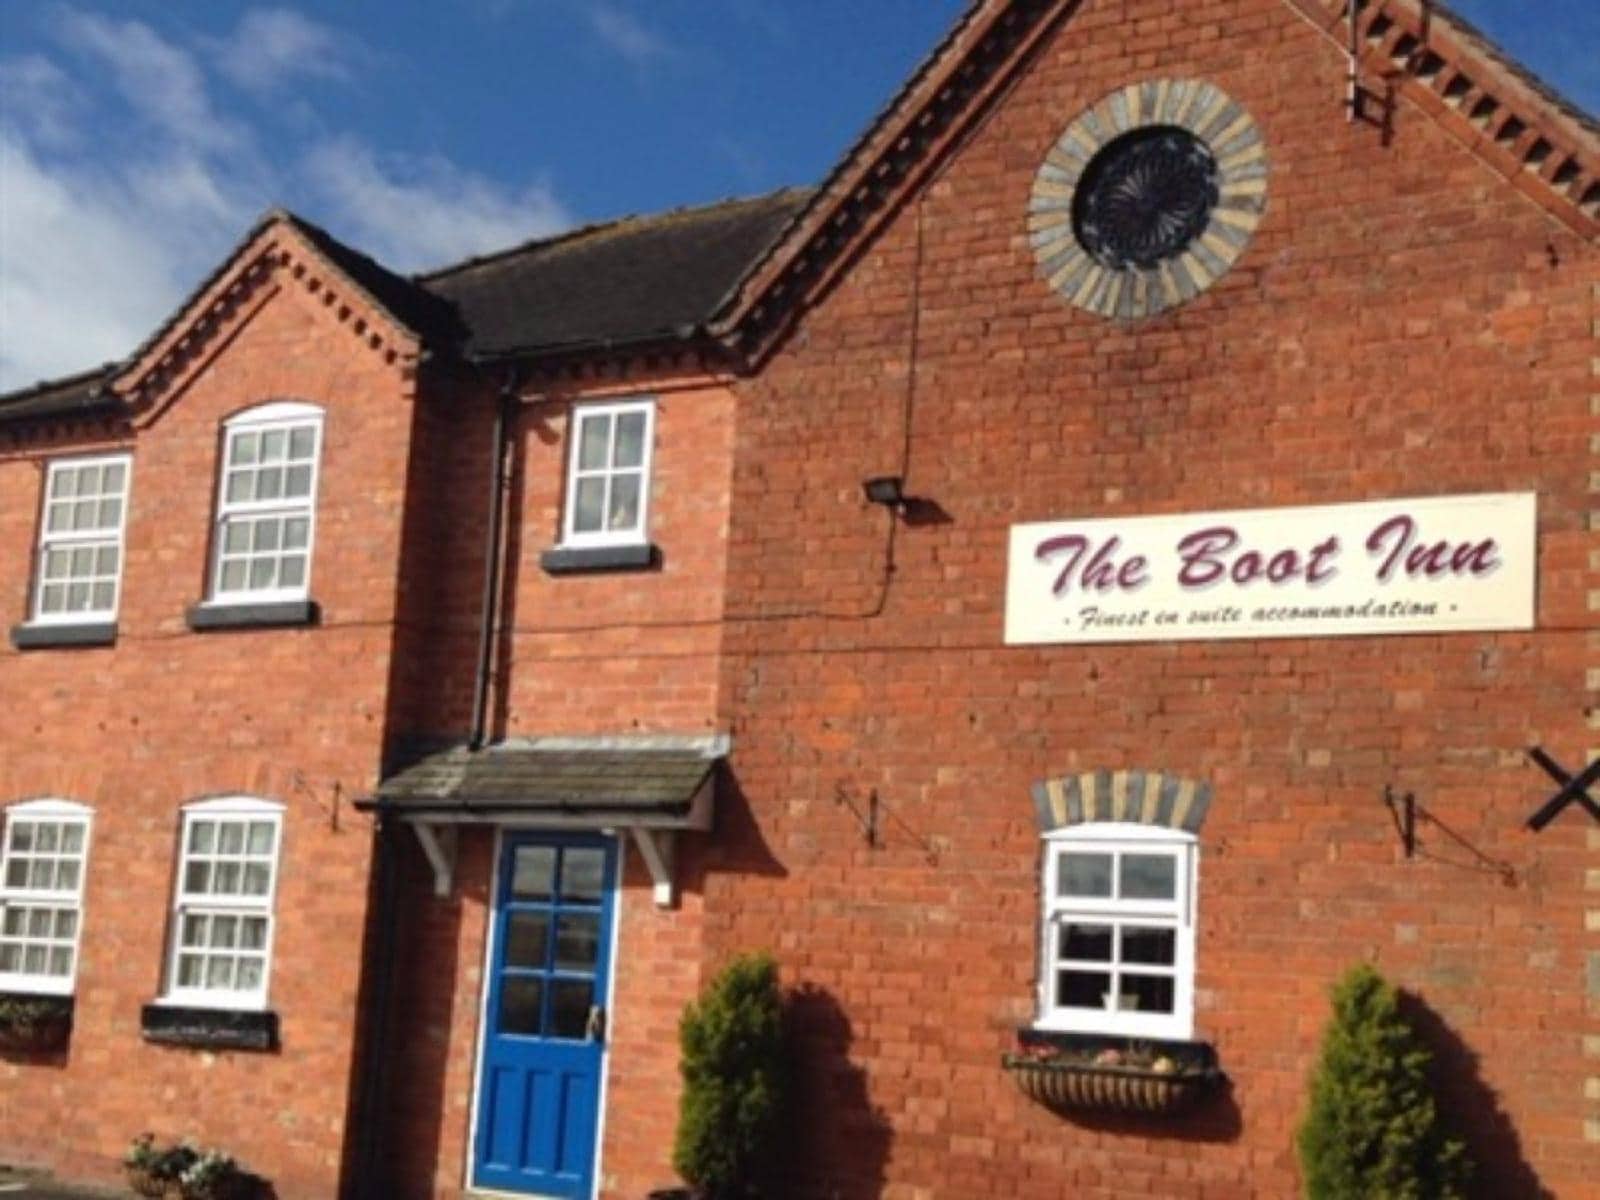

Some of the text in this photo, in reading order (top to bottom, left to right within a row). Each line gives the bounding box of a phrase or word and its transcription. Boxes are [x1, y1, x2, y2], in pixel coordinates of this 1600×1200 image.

[1034, 513, 1501, 597] The Boot Inn
[1078, 597, 1438, 631] Finest en suite accommodation
